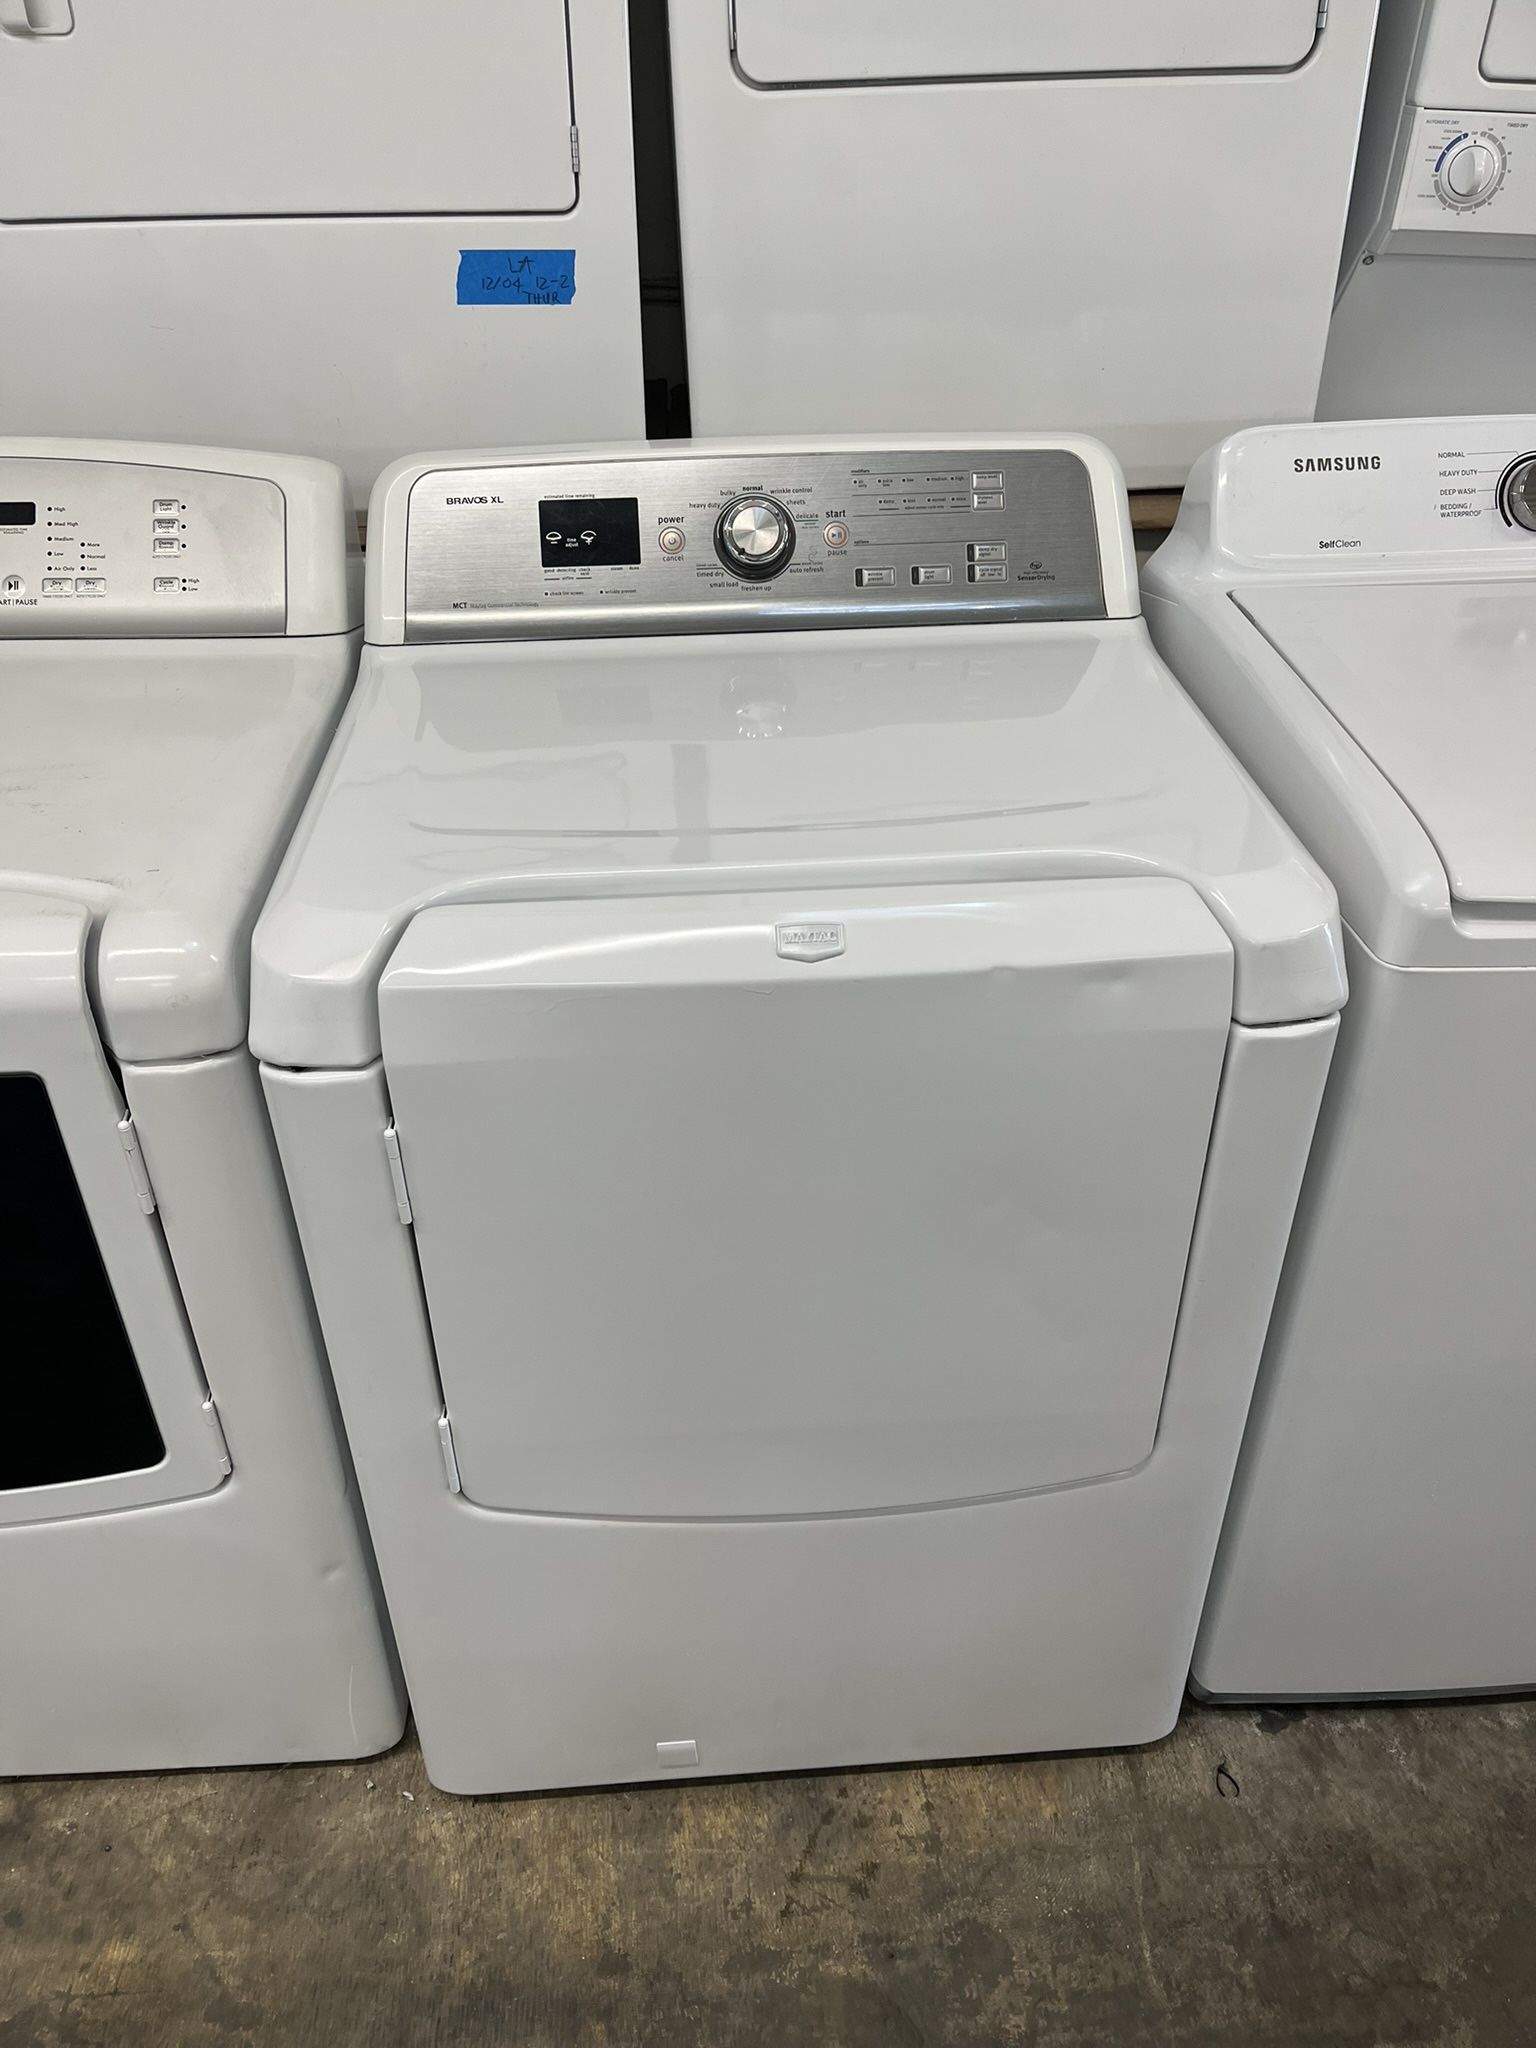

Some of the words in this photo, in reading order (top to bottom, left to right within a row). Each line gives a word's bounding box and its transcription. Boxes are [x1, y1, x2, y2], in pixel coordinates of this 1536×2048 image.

[508, 256, 535, 274] LA
[481, 276, 522, 292] 12/04
[522, 290, 561, 305] THUR
[1294, 456, 1381, 472] SAMSUNG
[446, 496, 488, 505] BRAVOS
[490, 496, 504, 504] XL
[826, 510, 846, 518] start
[1440, 510, 1482, 518] WATERPROOF
[658, 516, 684, 525] power
[1319, 539, 1361, 549] SelfClean
